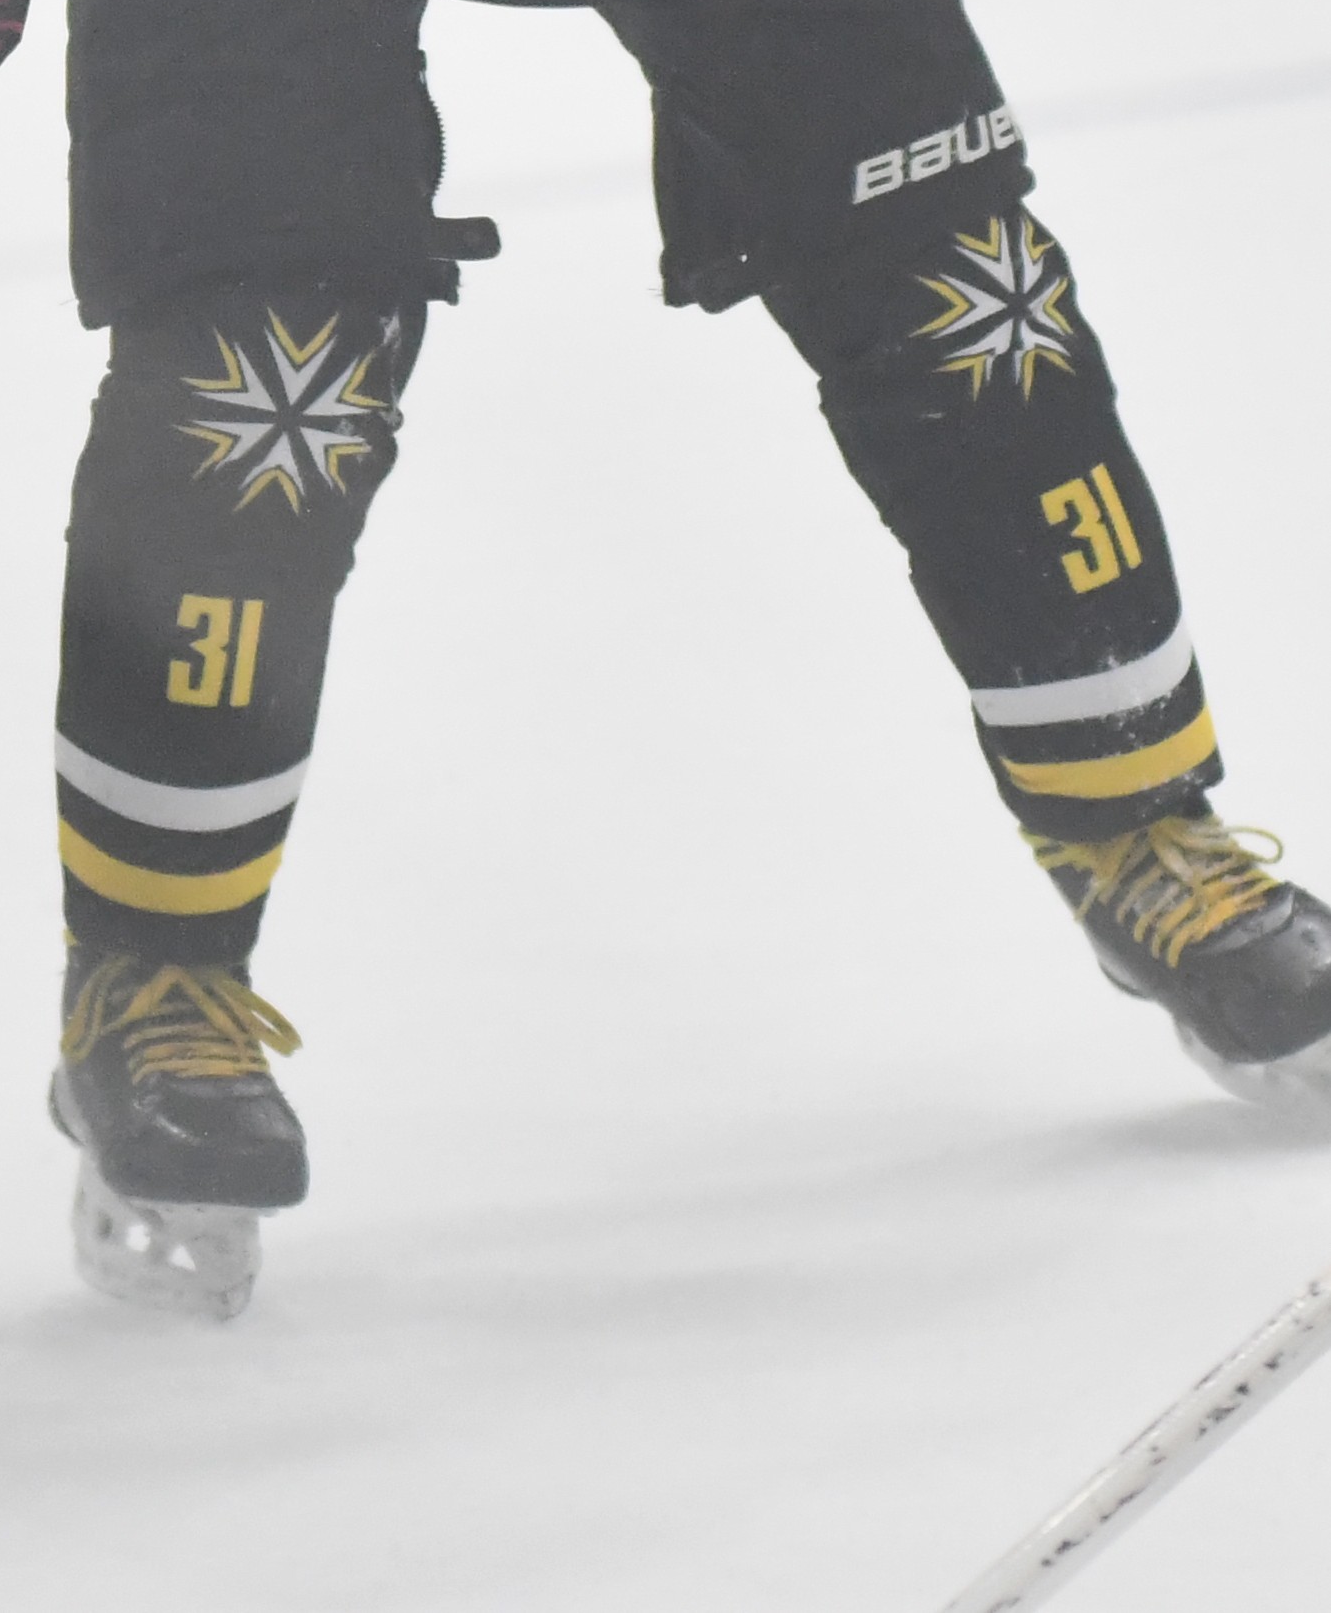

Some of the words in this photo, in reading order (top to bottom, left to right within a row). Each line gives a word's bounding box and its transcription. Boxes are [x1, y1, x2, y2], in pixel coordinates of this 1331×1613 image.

[852, 105, 1022, 205] BAUE
[1040, 463, 1142, 594] 31
[167, 594, 264, 708] 31
